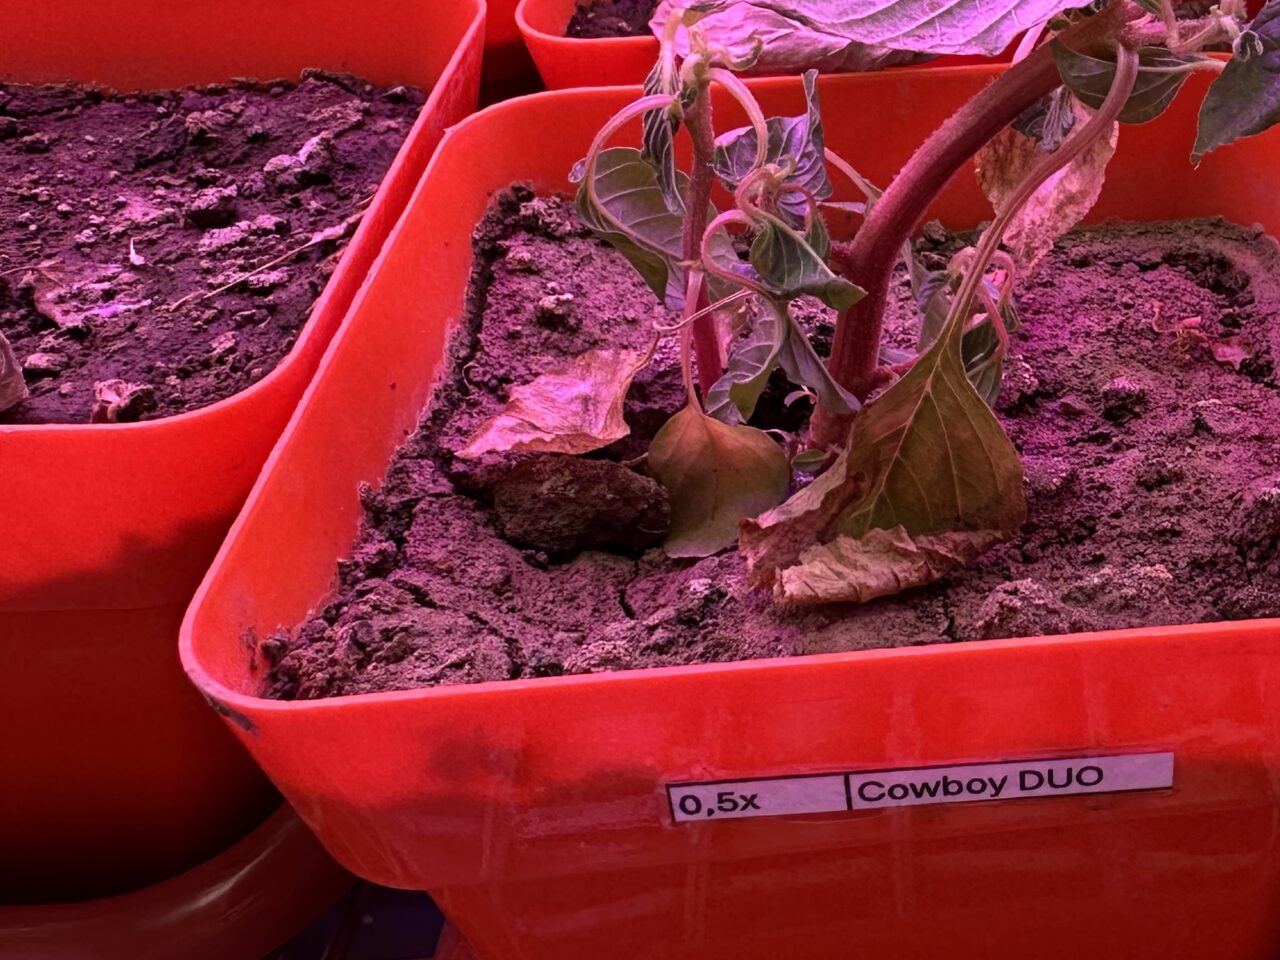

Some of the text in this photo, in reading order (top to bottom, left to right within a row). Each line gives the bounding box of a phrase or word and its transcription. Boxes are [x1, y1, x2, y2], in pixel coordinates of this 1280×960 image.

[679, 765, 1104, 817] 0,5x Cowboy DUO
